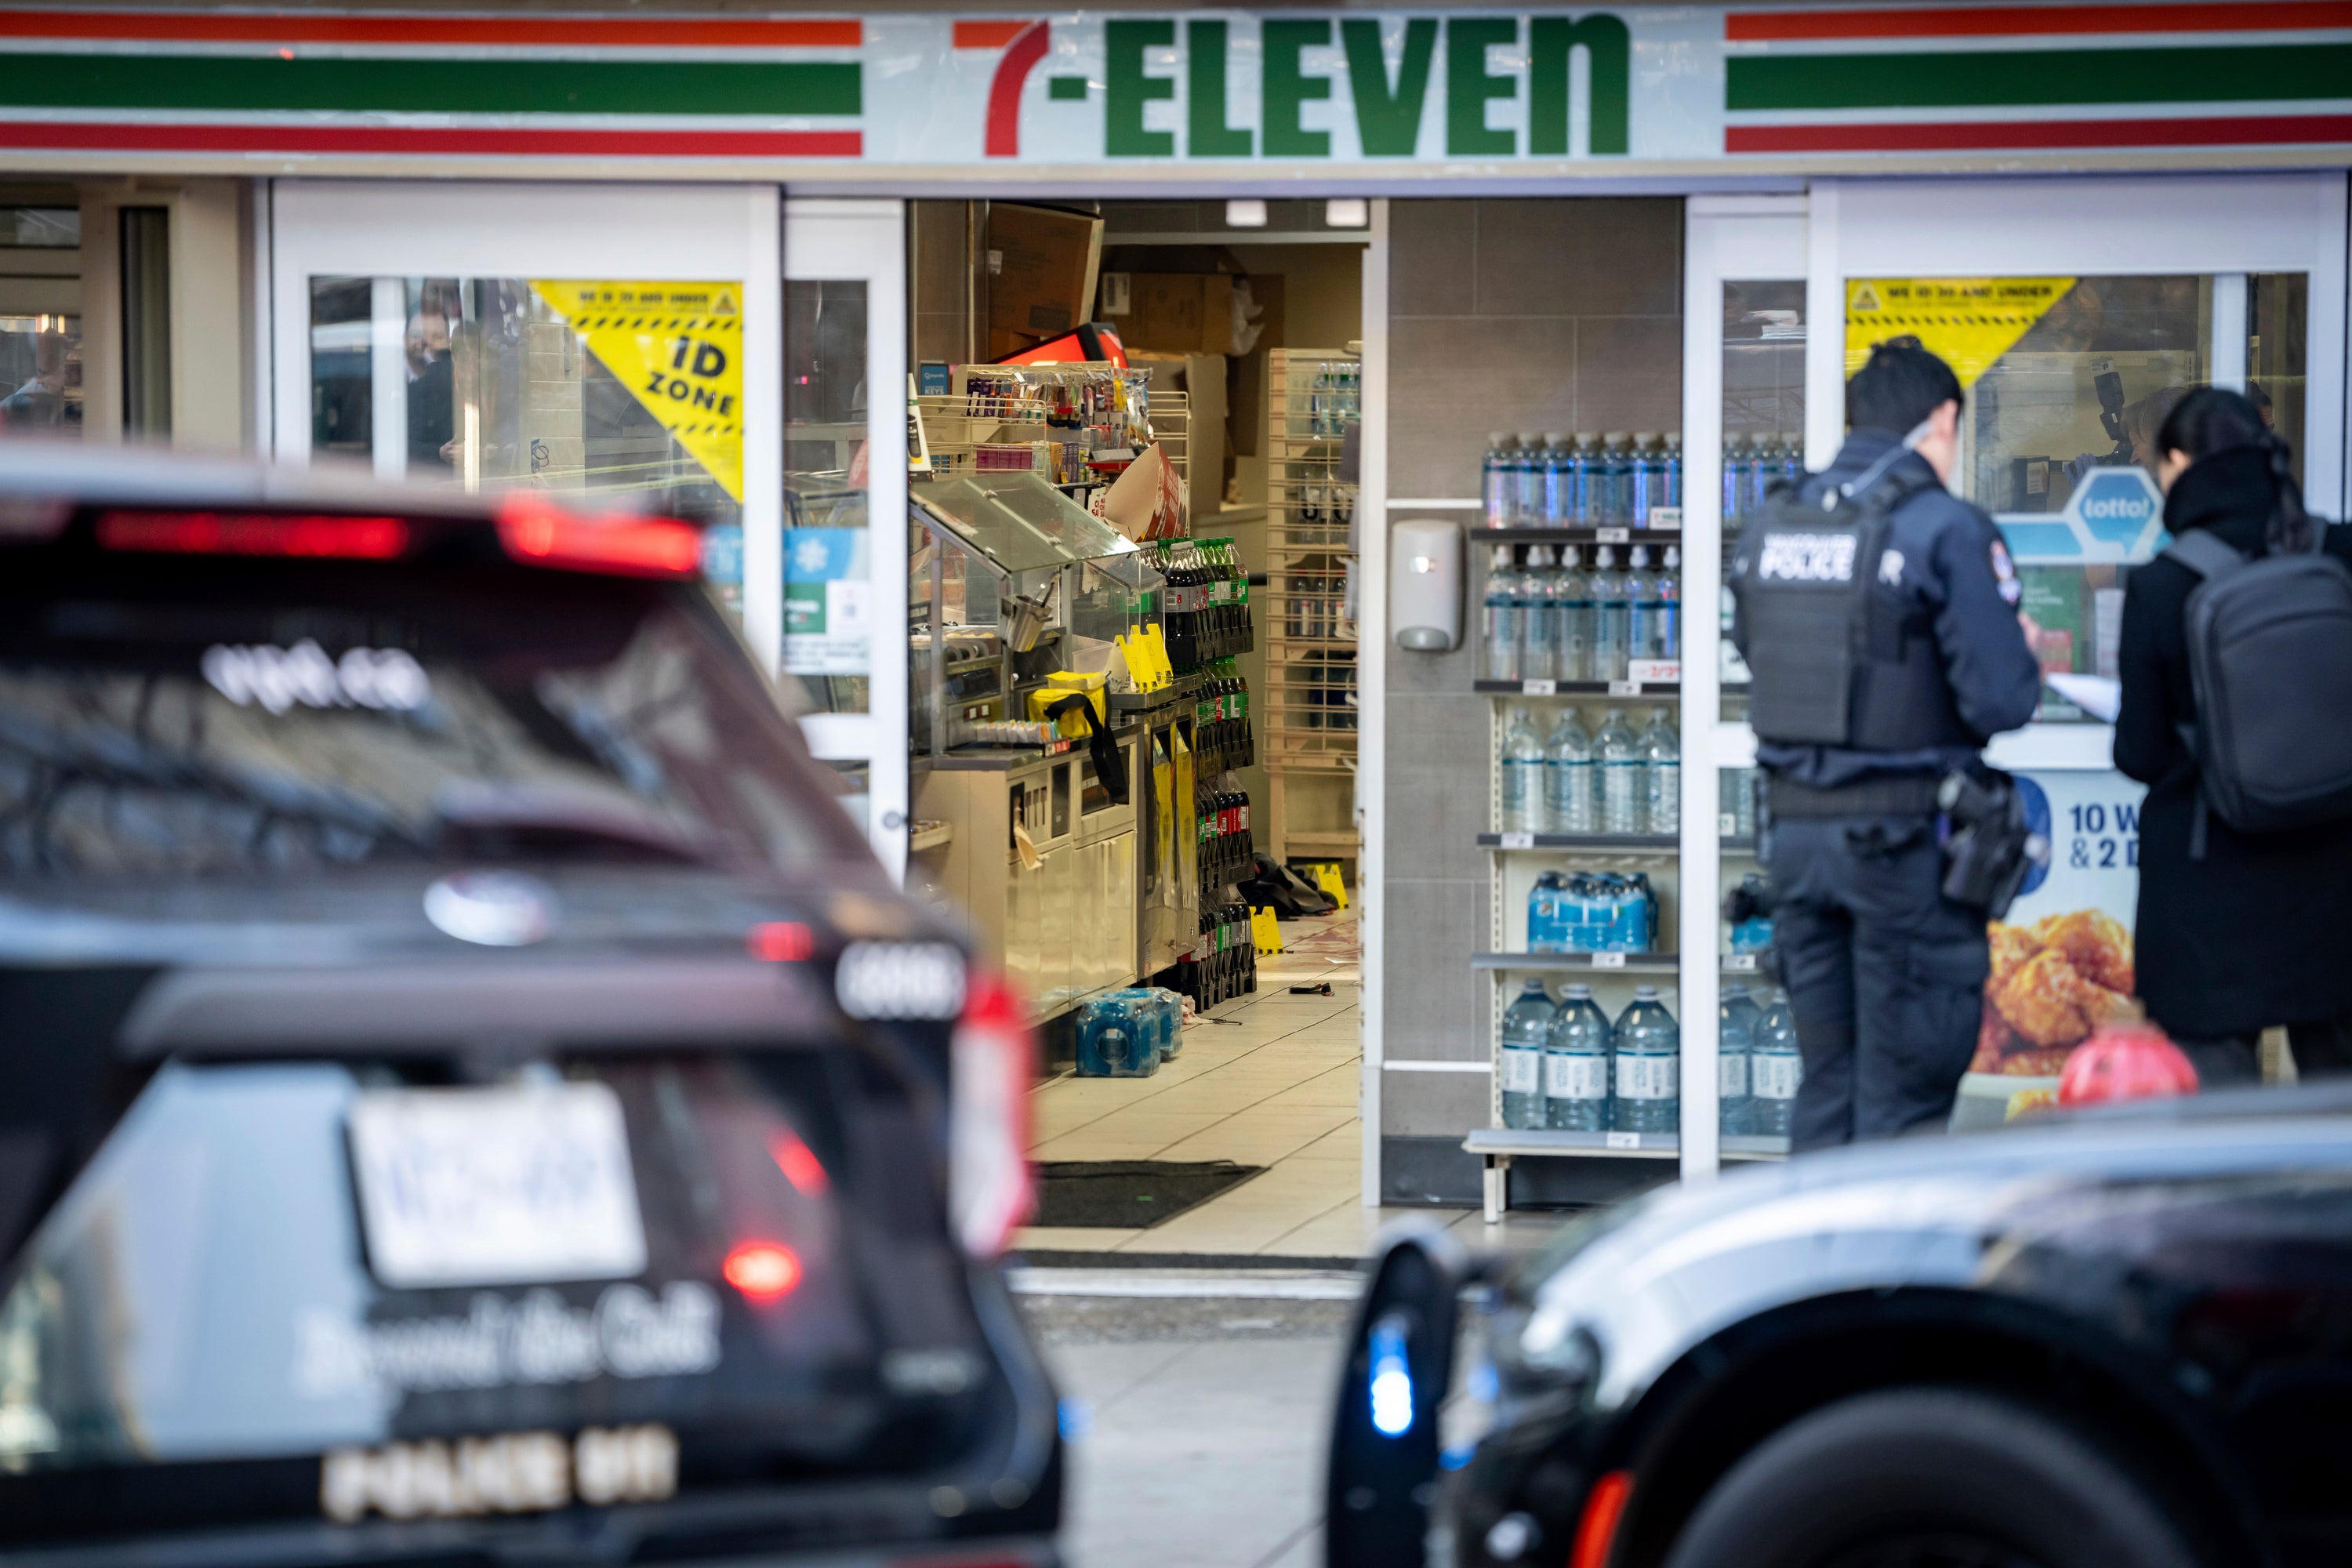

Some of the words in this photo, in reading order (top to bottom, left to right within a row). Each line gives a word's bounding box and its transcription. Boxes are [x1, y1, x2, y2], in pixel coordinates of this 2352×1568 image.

[673, 335, 726, 379] ID
[645, 370, 735, 418] ZONE
[2083, 496, 2151, 519] lotto!
[1759, 548, 1853, 581] POLICE
[2070, 804, 2105, 833] 10
[2070, 837, 2089, 869] &
[2099, 838, 2116, 868] 2
